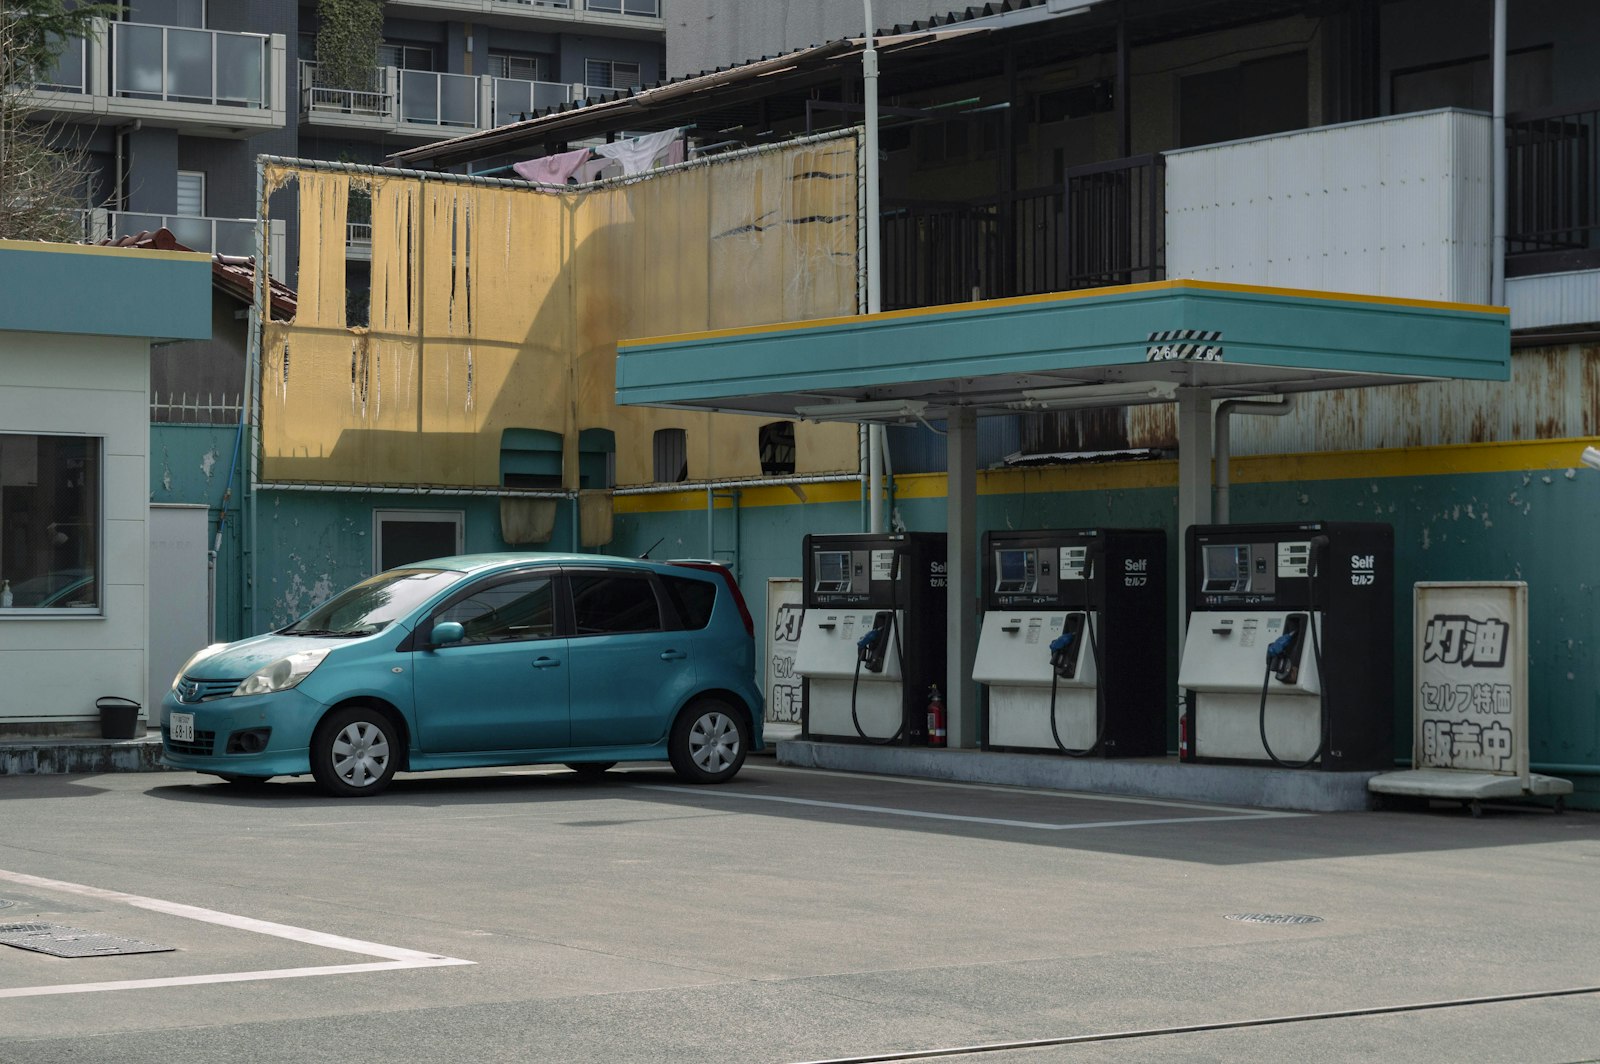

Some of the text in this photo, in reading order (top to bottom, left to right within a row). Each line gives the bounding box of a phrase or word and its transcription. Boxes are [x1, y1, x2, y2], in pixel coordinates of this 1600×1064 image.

[930, 561, 947, 573] Sel
[1124, 558, 1148, 571] Self
[1351, 555, 1375, 568] Self
[1124, 576, 1148, 587] セルフ
[1351, 574, 1375, 586] セルフ
[775, 603, 803, 642] 灯
[1423, 614, 1510, 668] 灯油
[1421, 682, 1512, 714] セルフ特価
[1422, 719, 1513, 771] 販売中
